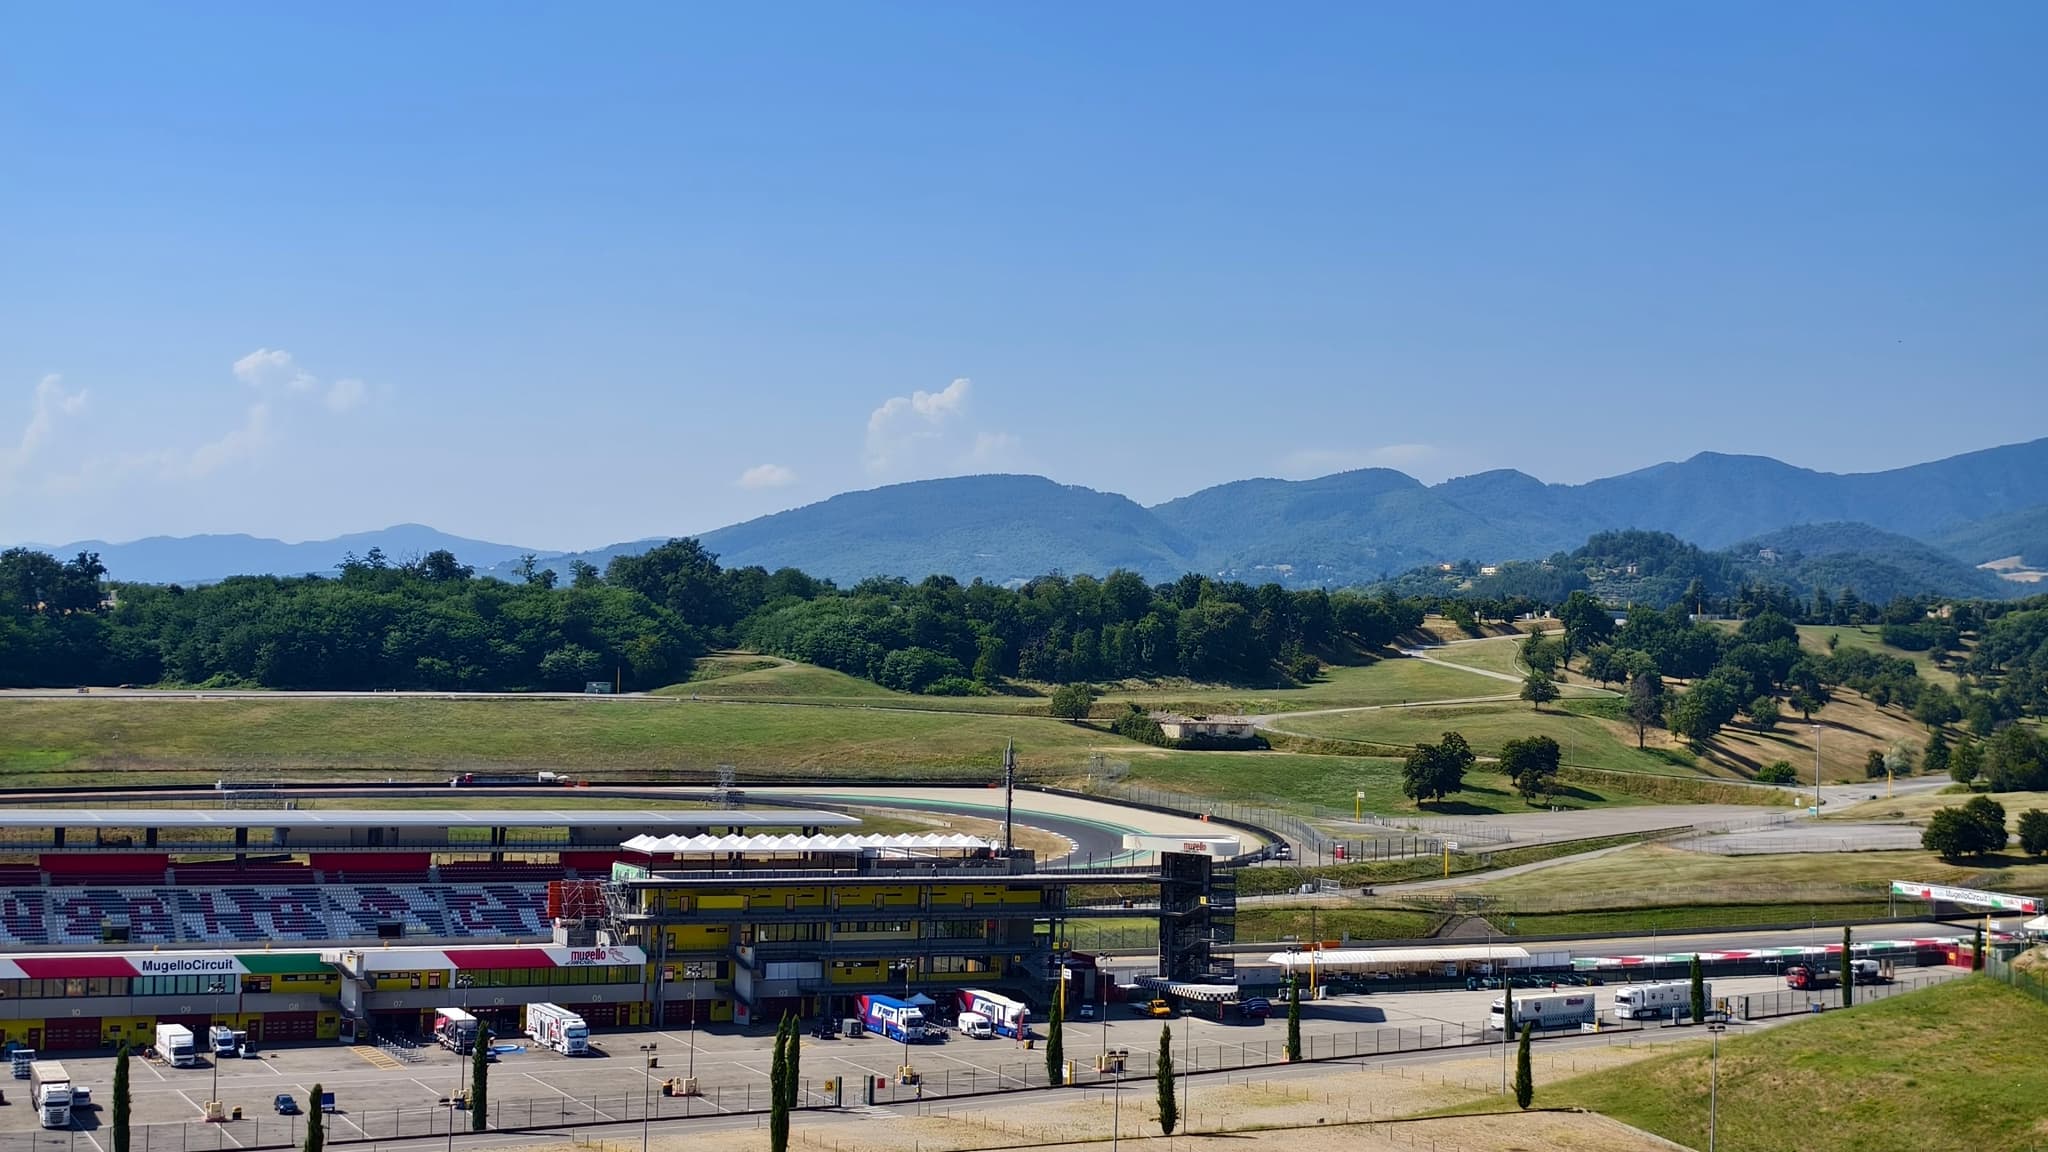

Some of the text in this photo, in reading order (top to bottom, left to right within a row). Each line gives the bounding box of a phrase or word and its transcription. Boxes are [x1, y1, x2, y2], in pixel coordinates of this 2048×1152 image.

[571, 948, 606, 961] mugello
[142, 959, 233, 973] MugelloCircuit
[71, 1008, 80, 1016] 10
